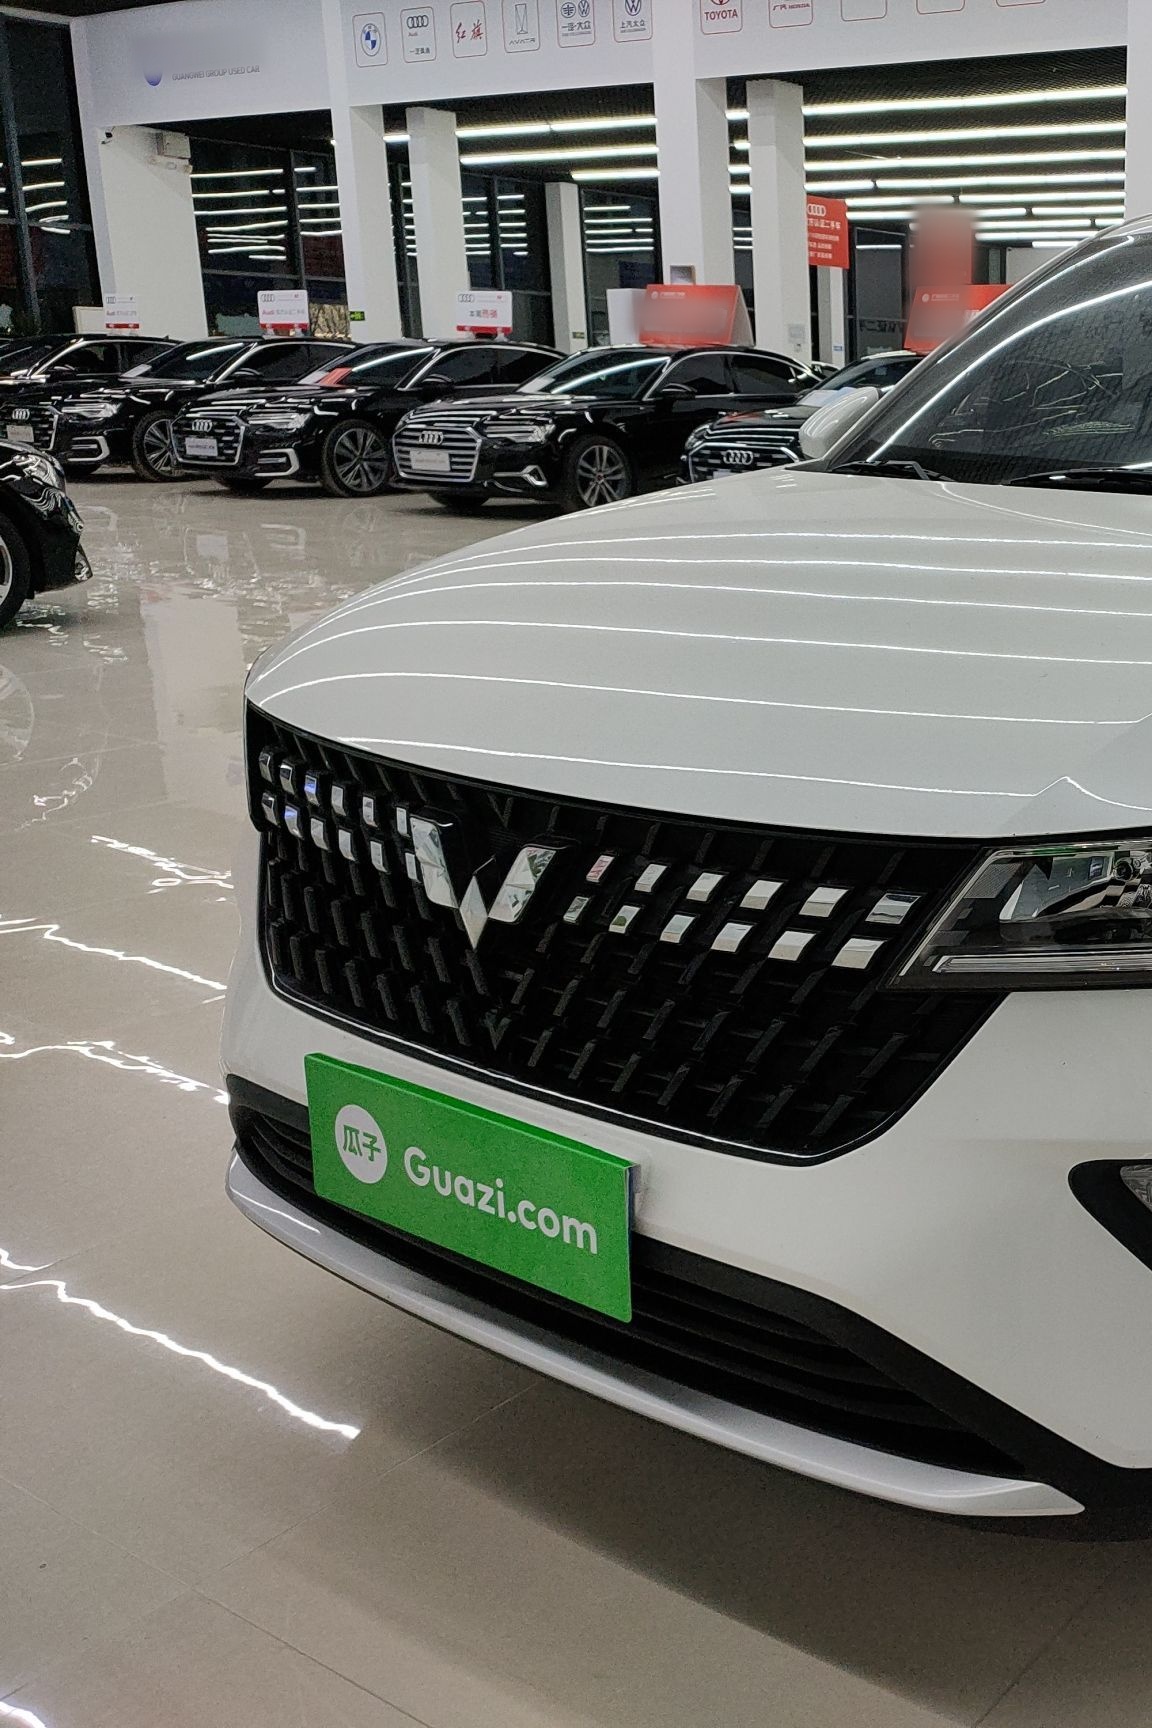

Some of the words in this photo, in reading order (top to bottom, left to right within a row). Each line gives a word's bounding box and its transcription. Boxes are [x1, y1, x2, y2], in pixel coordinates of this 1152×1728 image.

[704, 9, 738, 20] TOYOTA
[205, 69, 227, 77] GROUP
[228, 67, 245, 75] USED
[246, 65, 260, 73] CAR
[343, 1125, 382, 1161] 瓜子
[403, 1146, 598, 1255] Guazi.com
